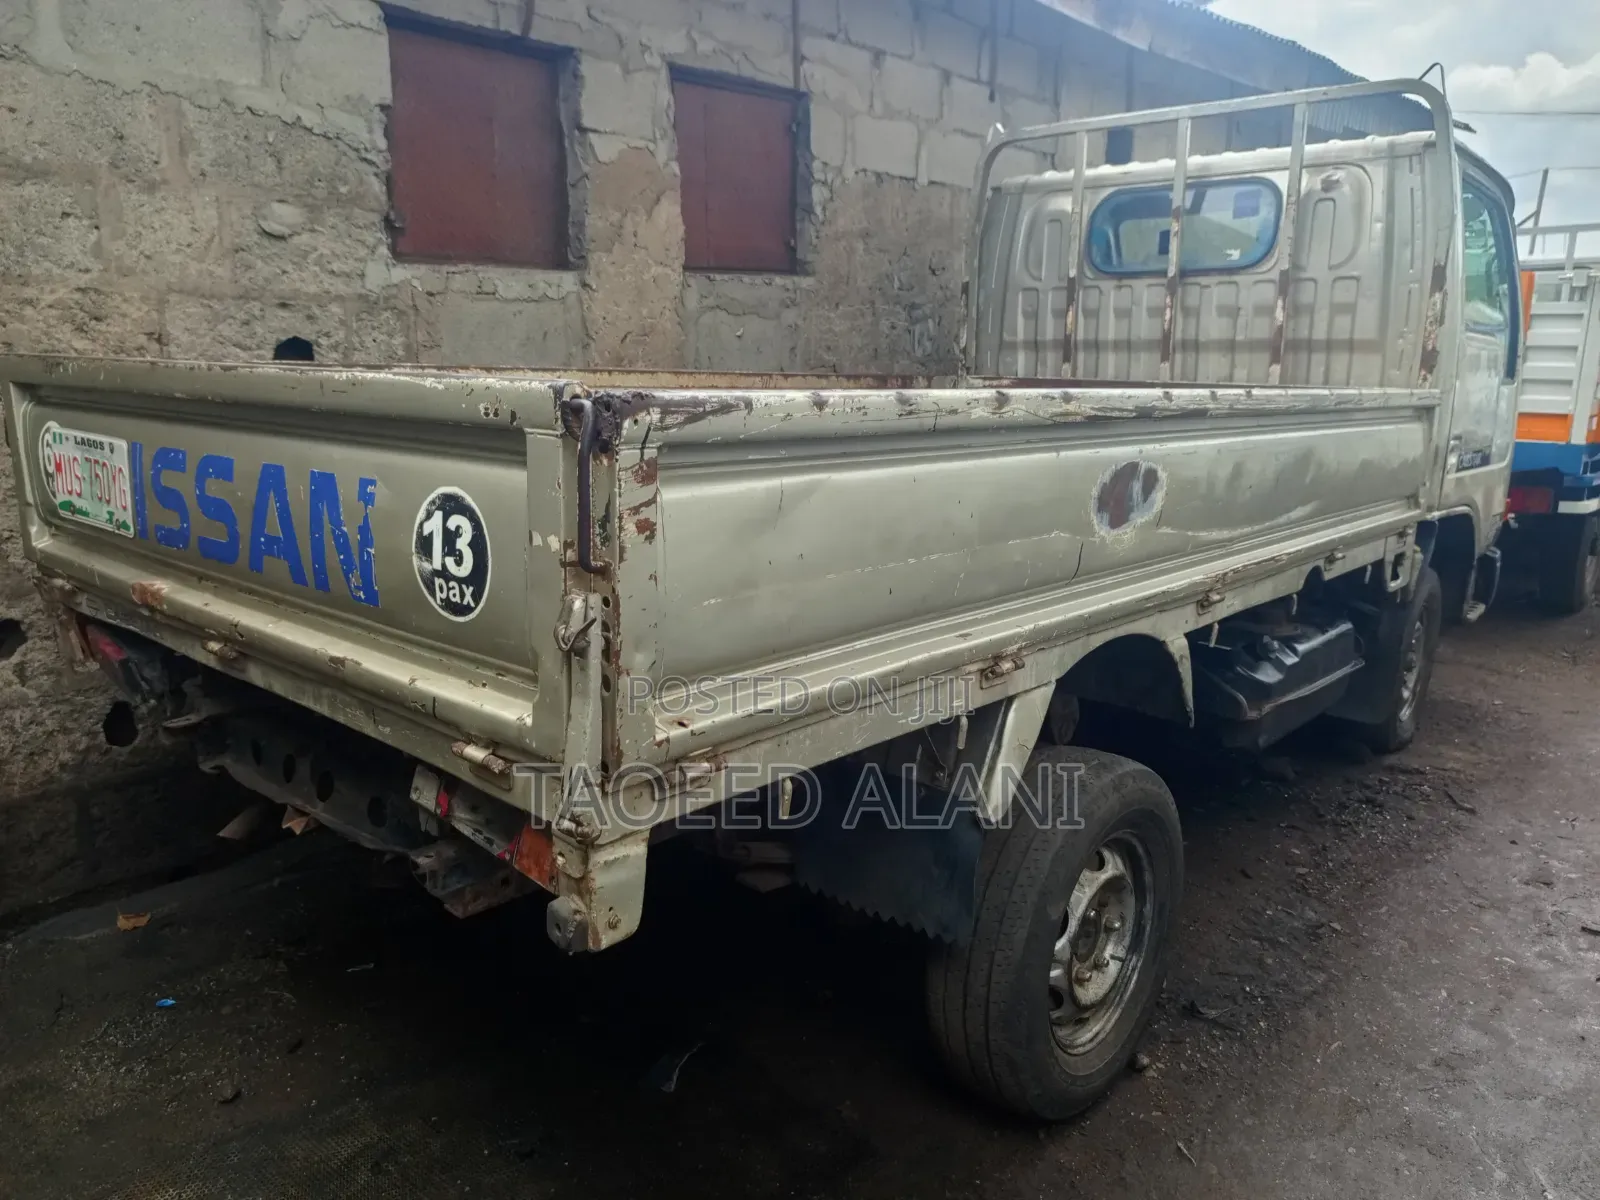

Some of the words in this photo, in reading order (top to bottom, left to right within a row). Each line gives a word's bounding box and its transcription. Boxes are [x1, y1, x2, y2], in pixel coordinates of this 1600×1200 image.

[74, 435, 105, 451] LAGOS
[131, 441, 381, 608] ISSAN
[422, 510, 474, 578] 13
[434, 576, 476, 608] pax
